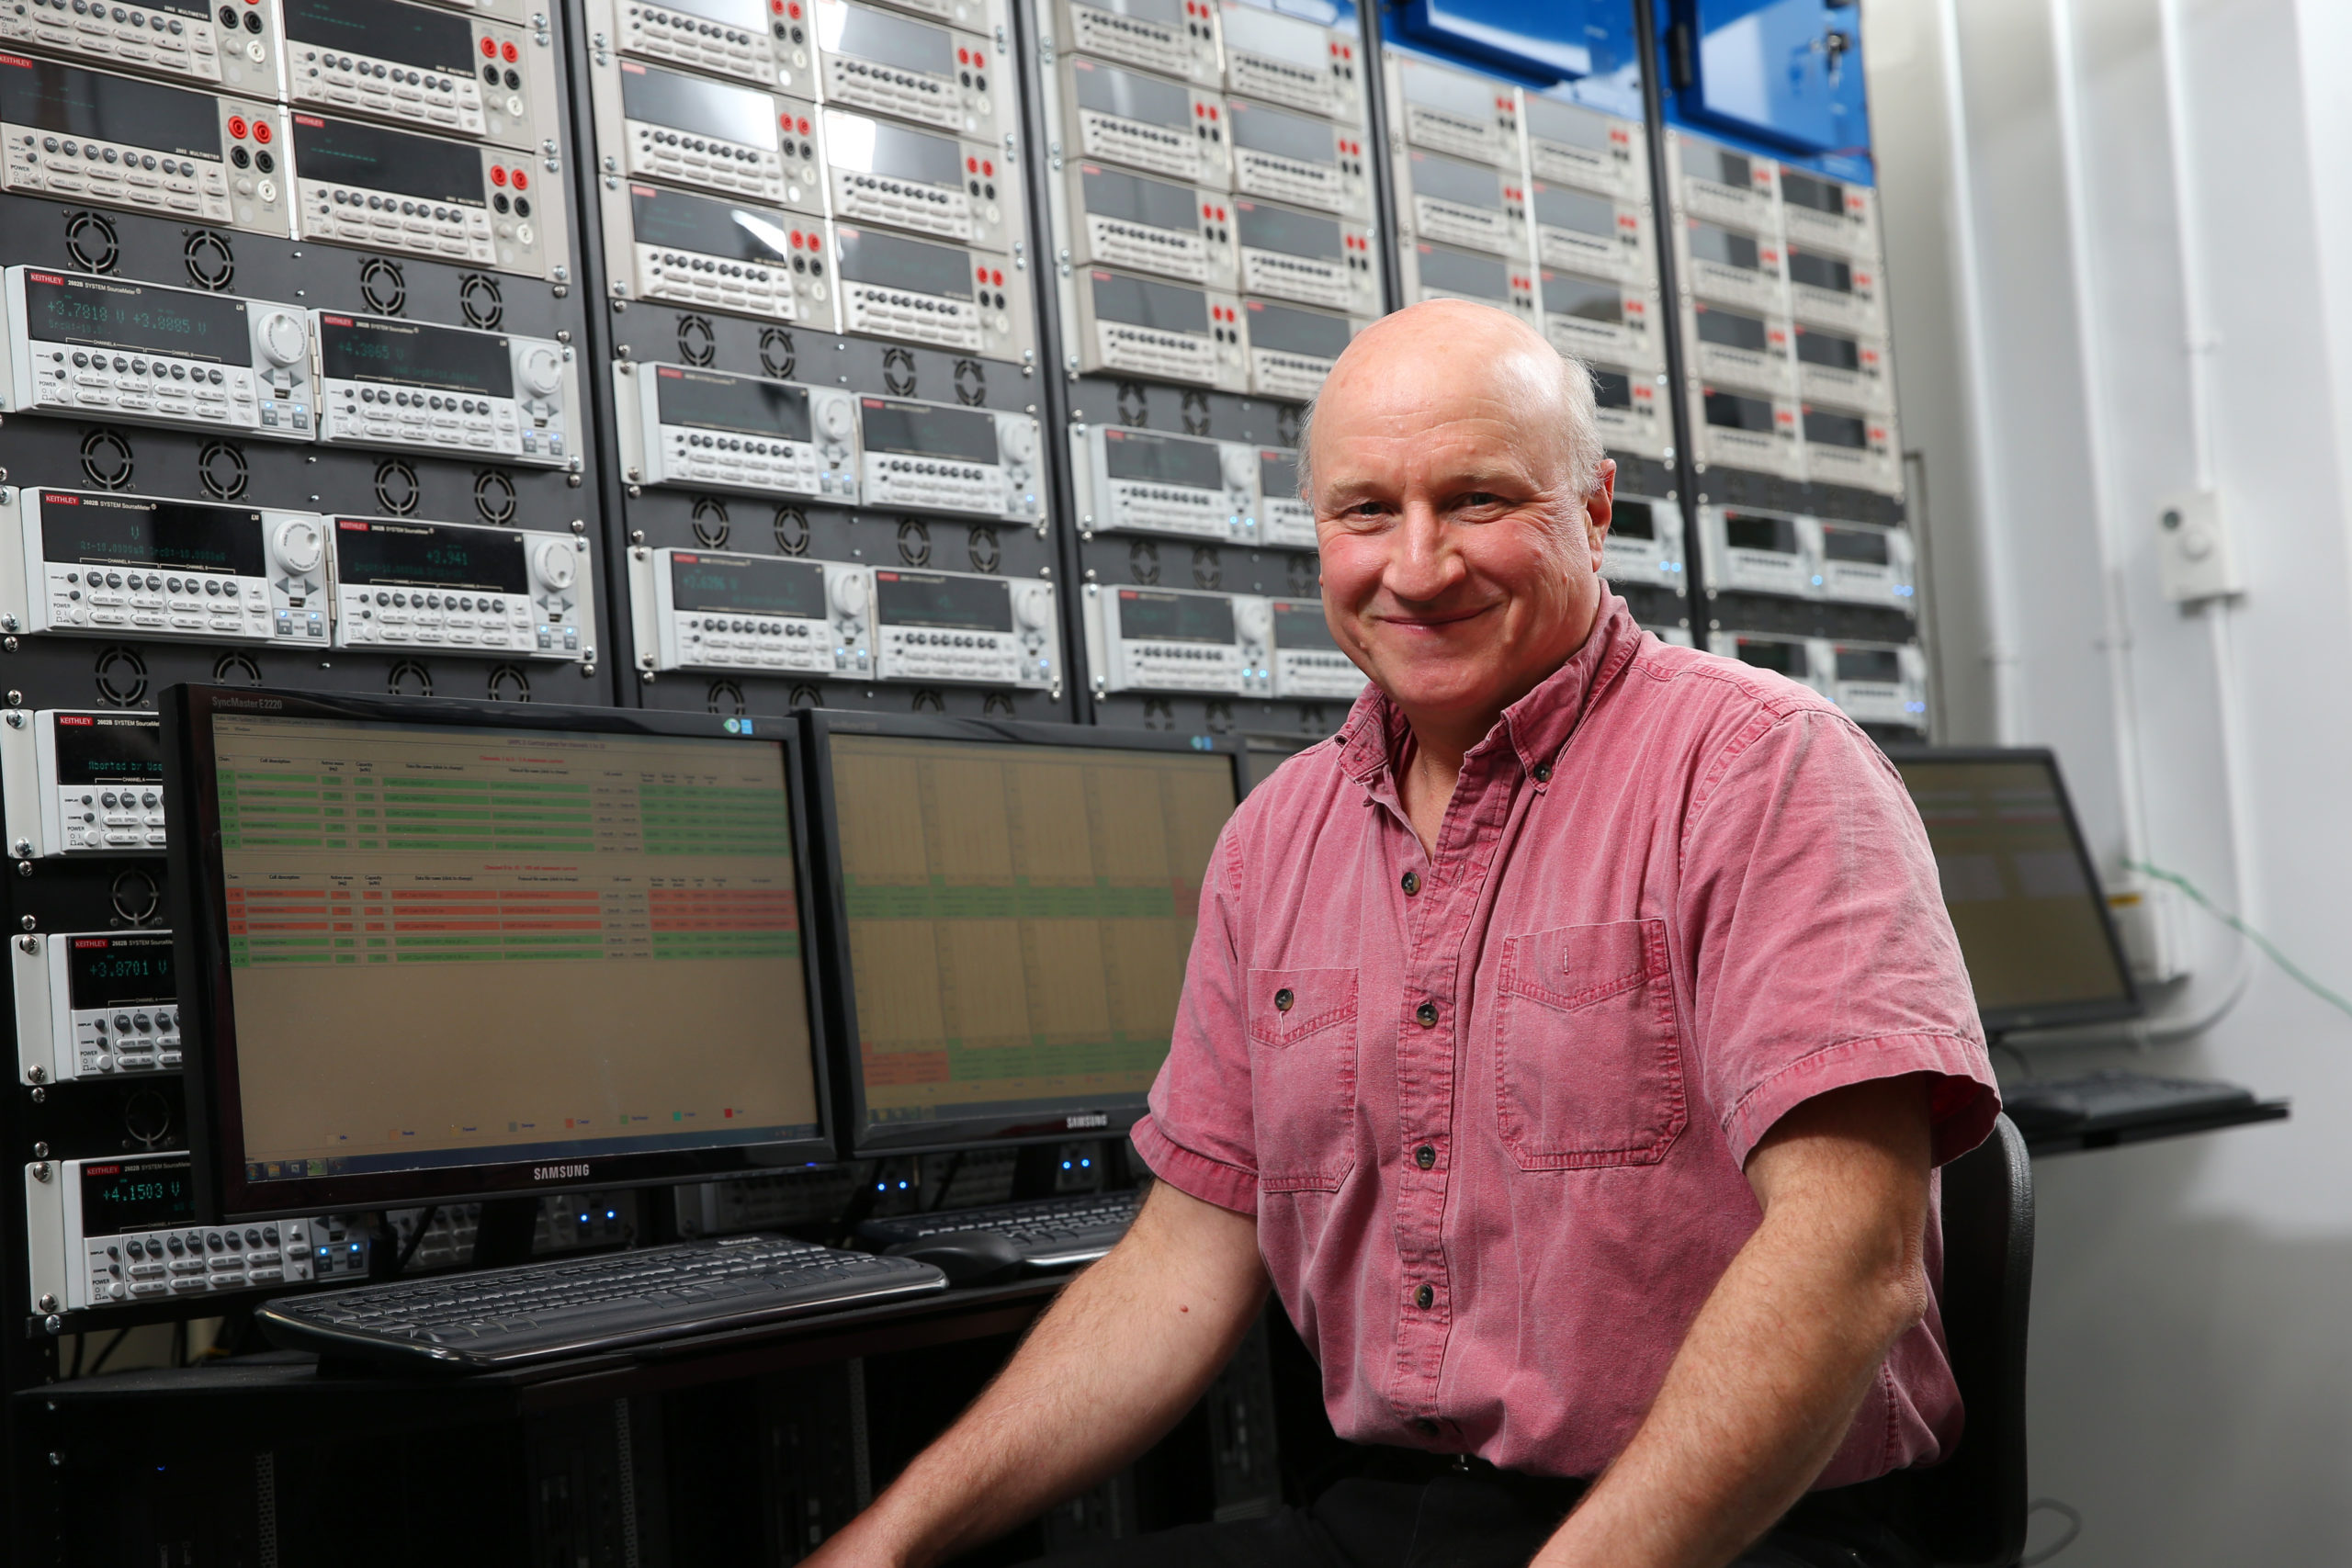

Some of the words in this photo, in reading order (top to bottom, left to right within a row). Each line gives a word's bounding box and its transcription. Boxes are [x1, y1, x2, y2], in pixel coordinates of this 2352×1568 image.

[177, 9, 209, 19] MULTIMETER
[189, 150, 220, 160] MULTIMETER
[30, 274, 62, 284] KEITHLEY
[85, 282, 107, 290] SYSTEM
[107, 286, 135, 295] SourceMeter
[46, 495, 76, 504] KEITHLEY
[122, 502, 150, 511] SourceMeter
[340, 522, 367, 530] KEITHLEY
[212, 697, 257, 707] SyncMaster
[259, 699, 282, 709] E2220
[88, 761, 126, 771] Aborted
[131, 762, 143, 771] by
[90, 960, 149, 976] +3.8701
[158, 960, 167, 975] V
[1067, 1115, 1108, 1129] SAMSUNG
[87, 1167, 118, 1175] KEITHLEY
[534, 1164, 590, 1180] SAMSUNG
[103, 1183, 163, 1201] +4.1503
[171, 1181, 180, 1197] V
